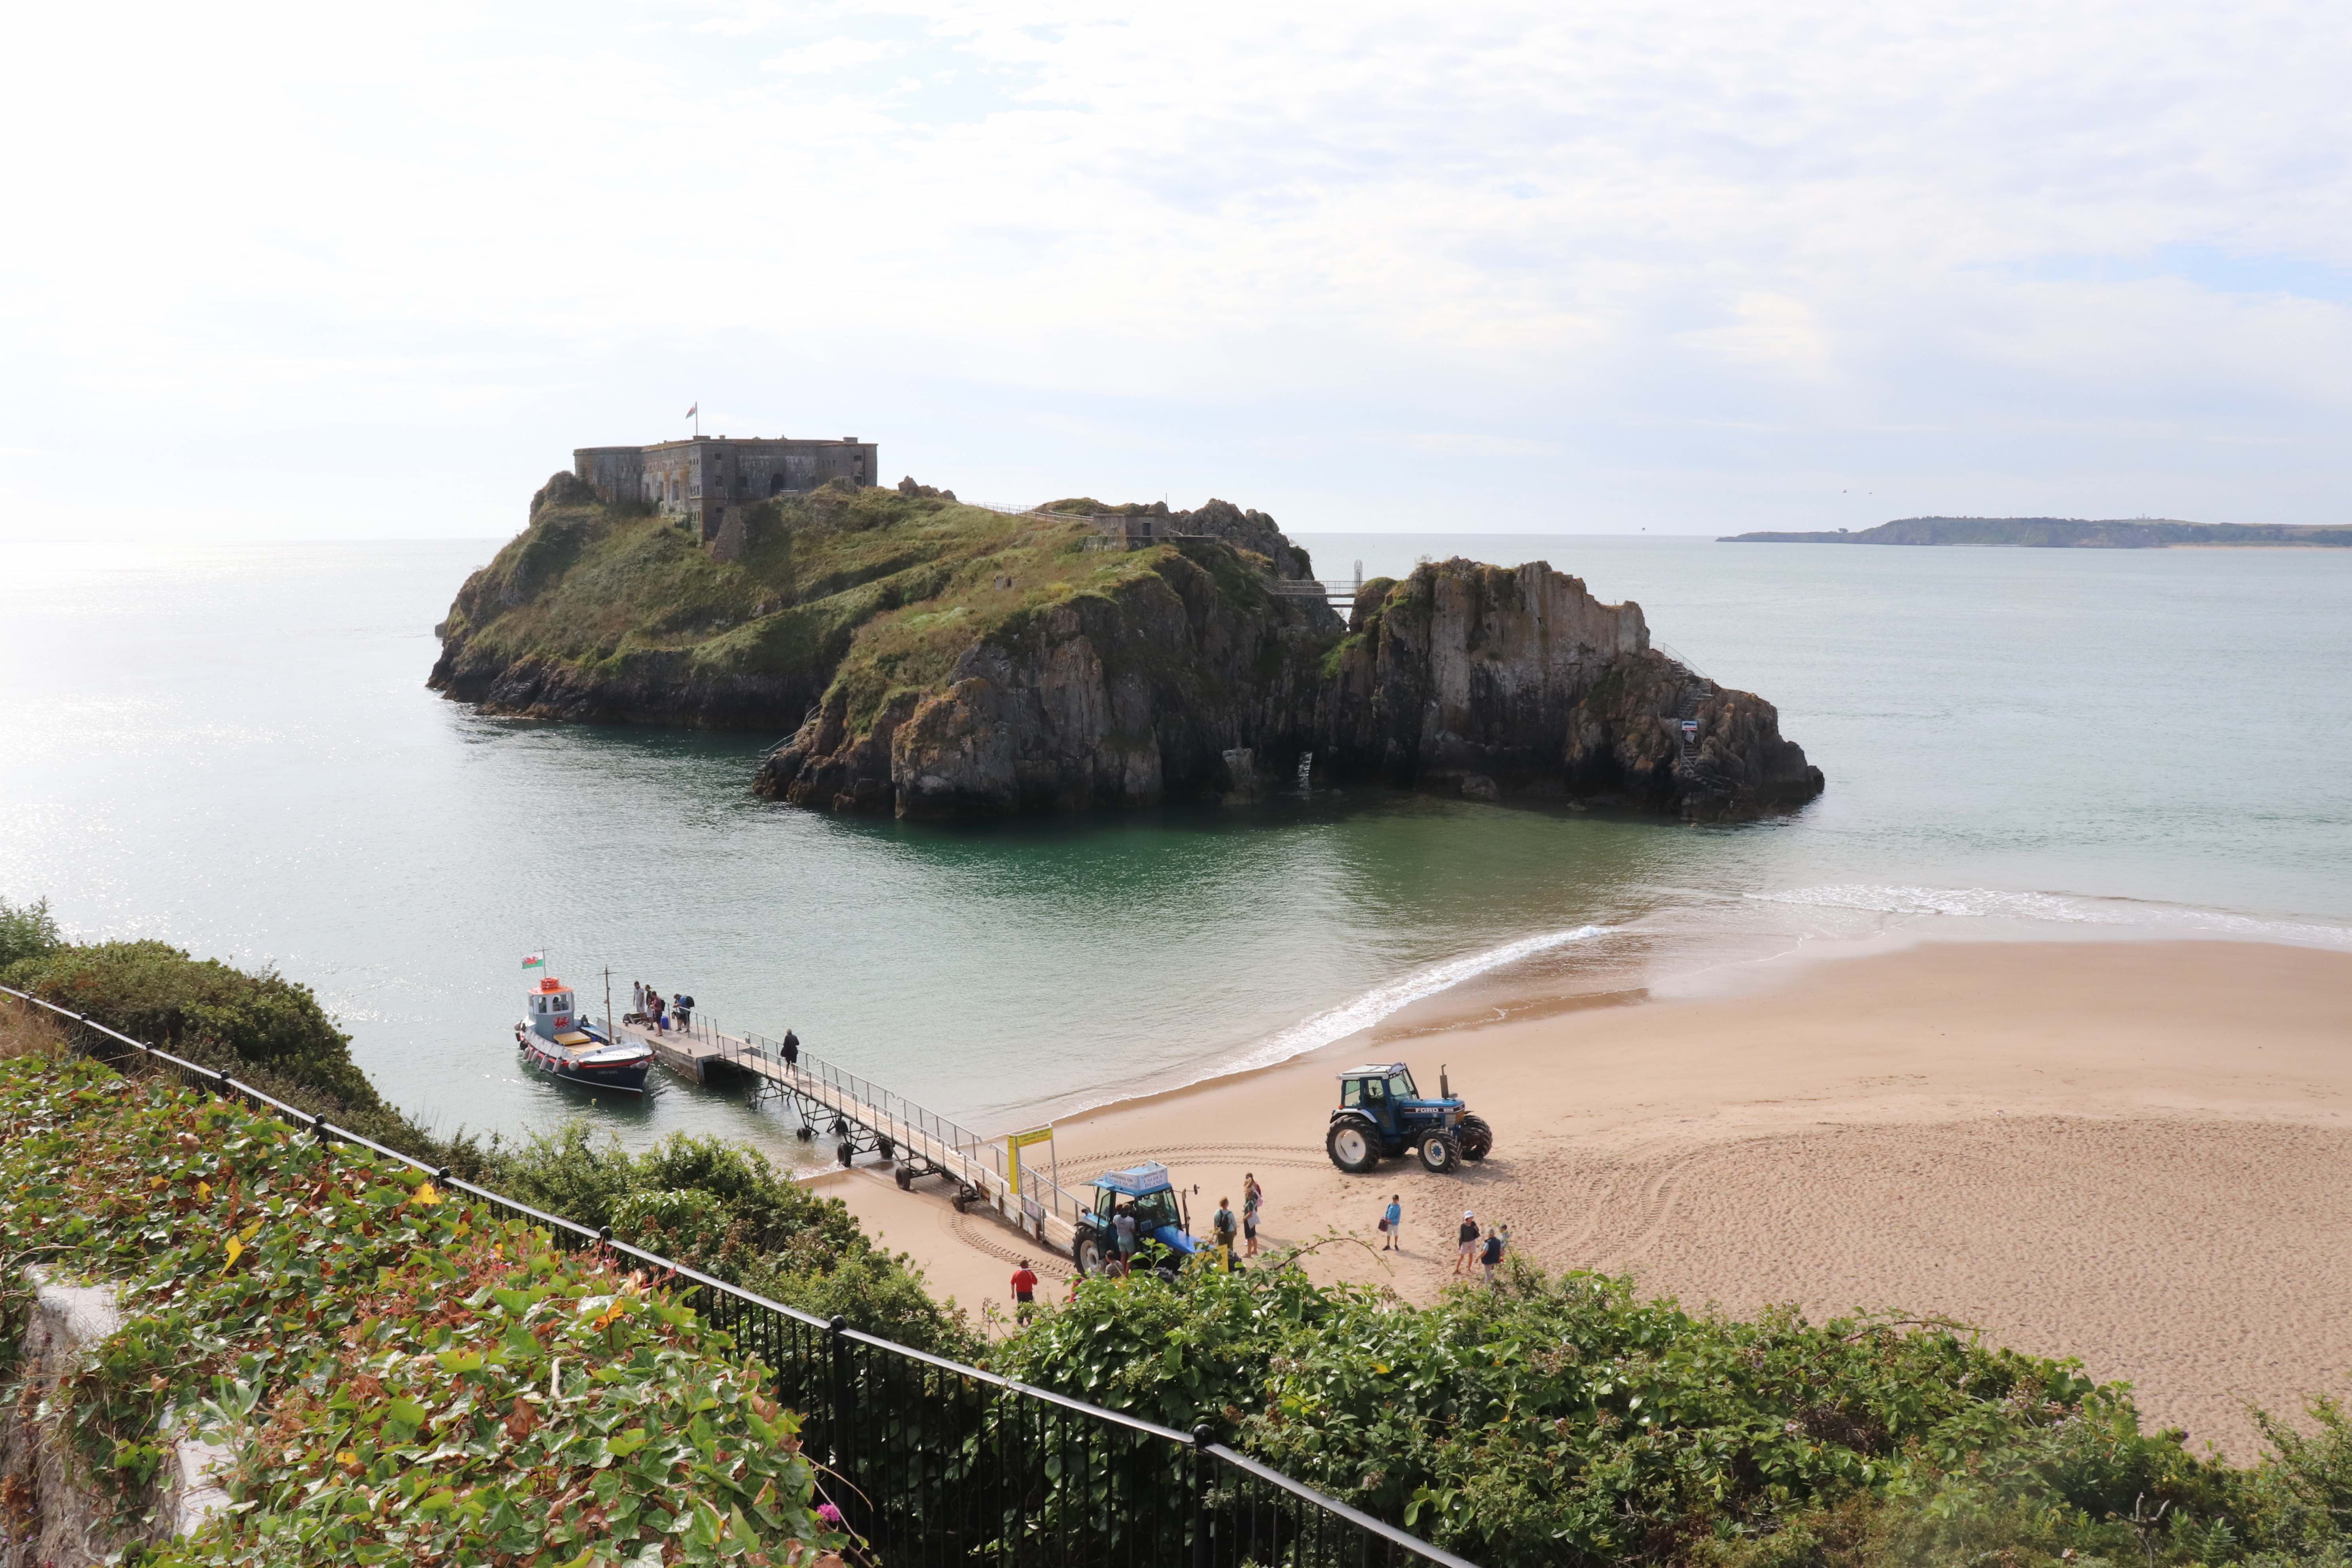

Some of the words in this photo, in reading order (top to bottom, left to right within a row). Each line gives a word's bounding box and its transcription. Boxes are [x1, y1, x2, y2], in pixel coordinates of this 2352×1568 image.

[1105, 1177, 1121, 1185] CALDEY
[1122, 1181, 1138, 1189] ISLAND
[1144, 1175, 1163, 1183] CALDEY
